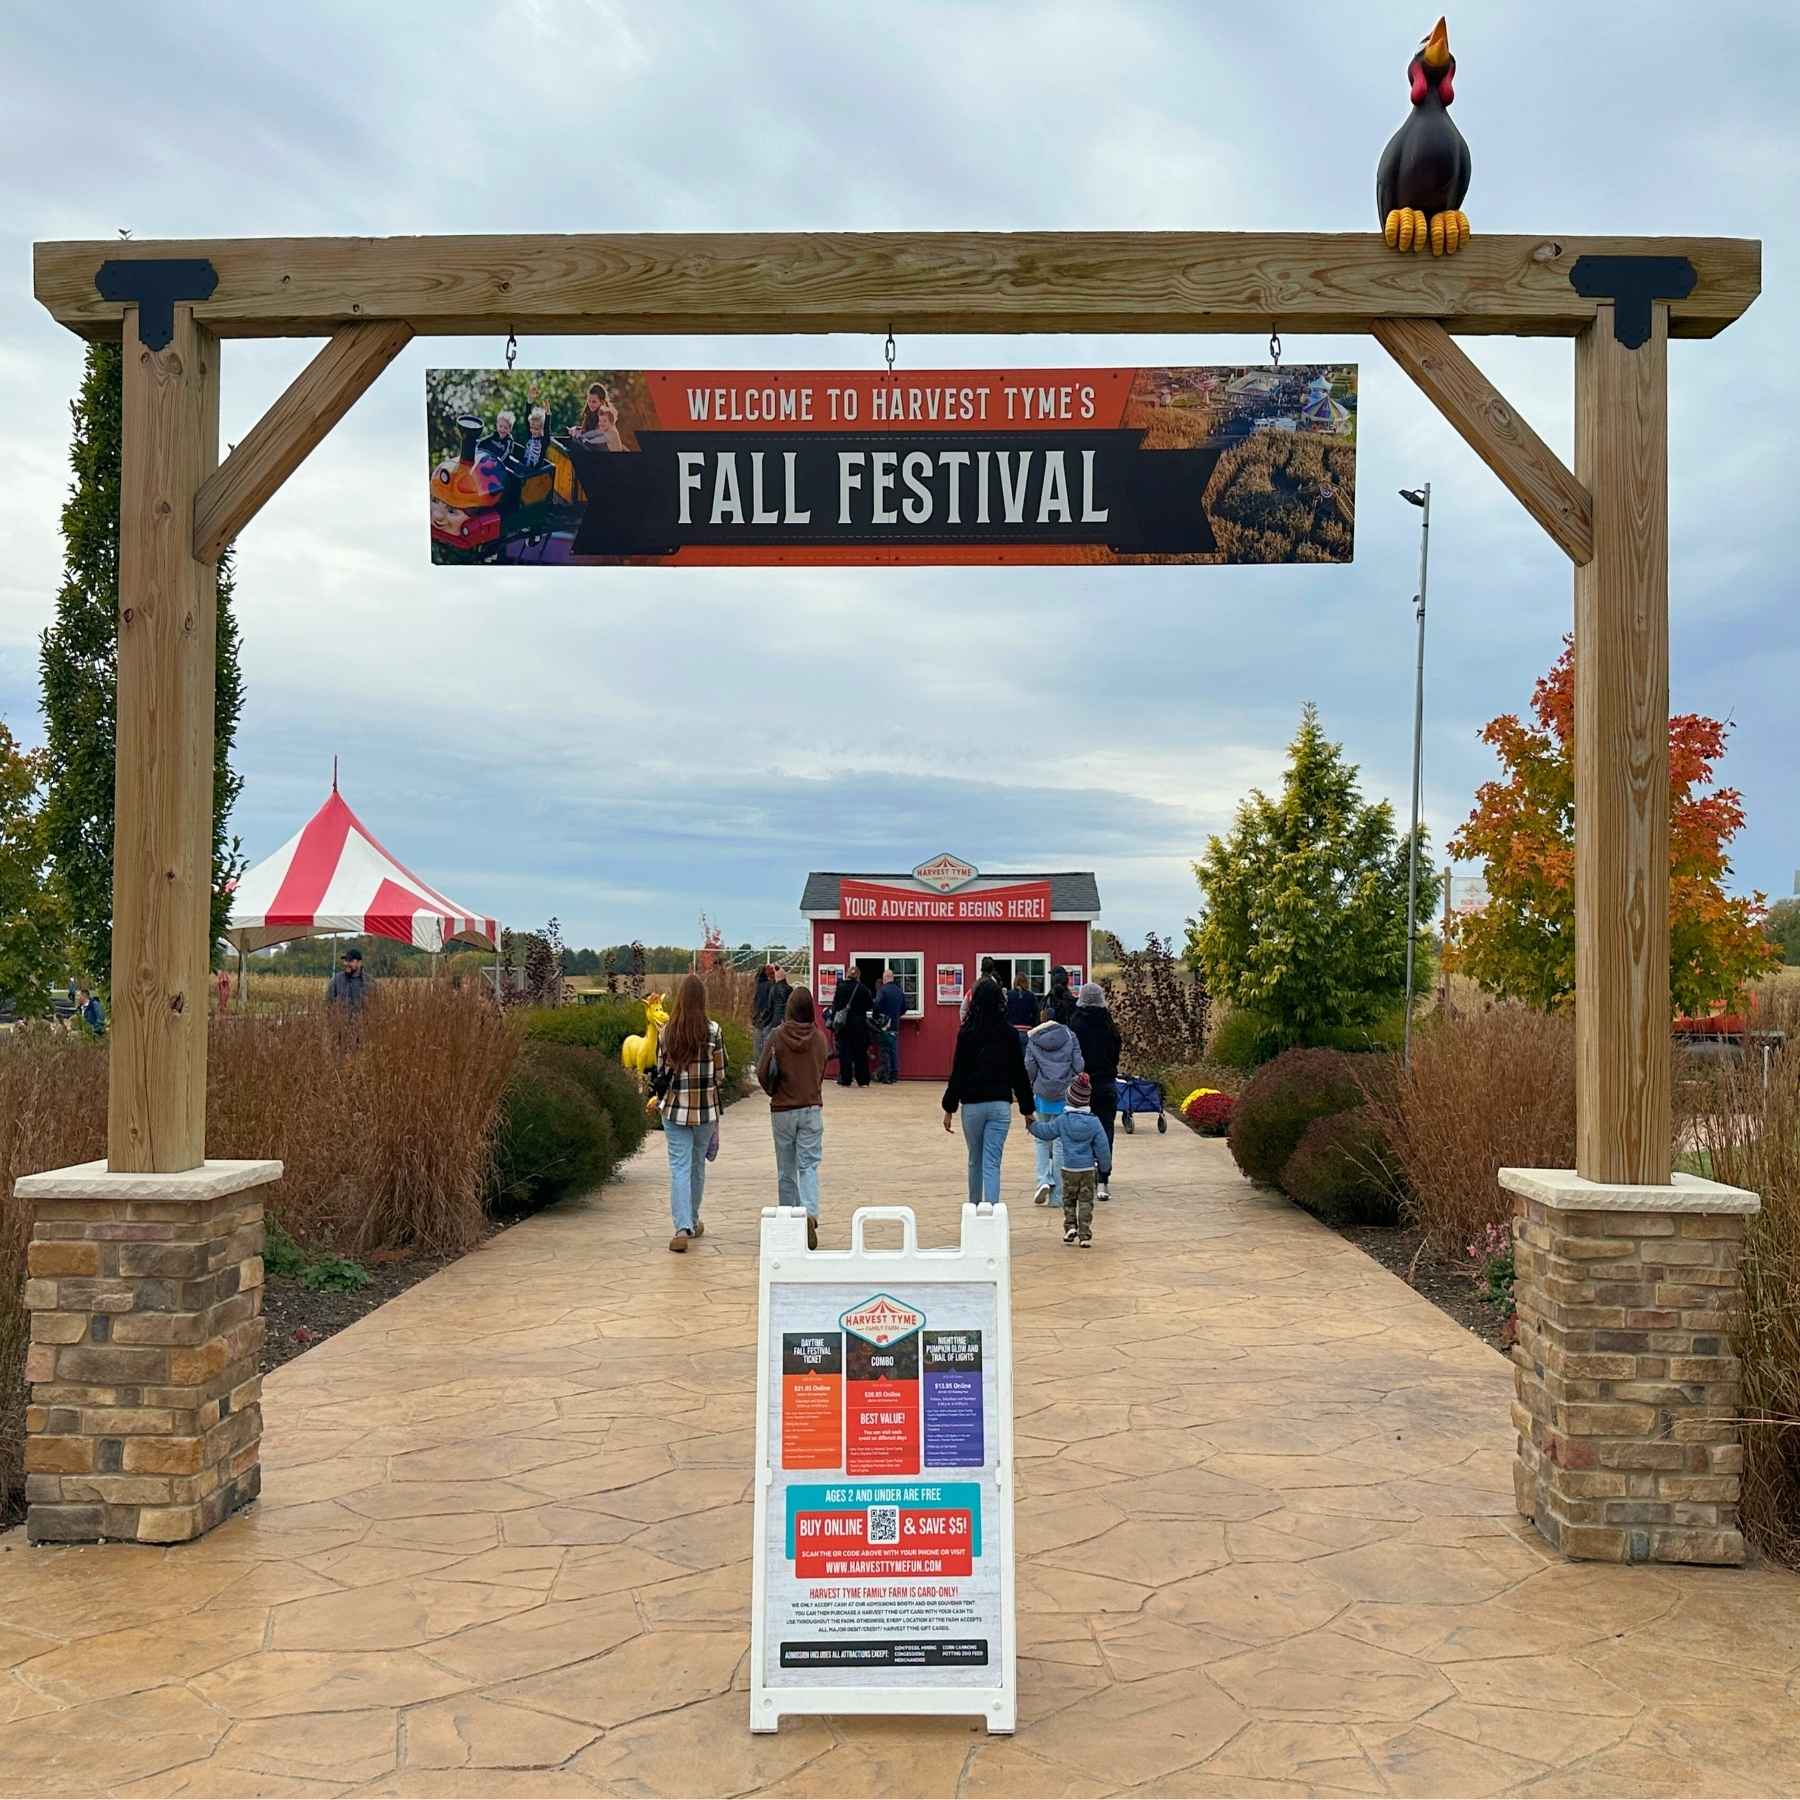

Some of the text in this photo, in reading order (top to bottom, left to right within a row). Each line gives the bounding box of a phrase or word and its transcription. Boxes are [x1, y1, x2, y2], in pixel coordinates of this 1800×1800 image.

[686, 383, 1095, 421] WELCOME TO HARVEST TYME'S
[677, 450, 1110, 524] FALL FESTIVAL
[917, 868, 972, 877] HARVEST TYME
[844, 897, 1045, 918] YOUR ADVENTURE BEGINS HERE!
[846, 1314, 917, 1326] HARVEST TYME
[793, 1346, 832, 1356] FALL FESTIVAL
[926, 1345, 951, 1353] PUMPKIN
[967, 1344, 979, 1353] AND
[803, 1355, 822, 1364] TICKET
[871, 1356, 895, 1367] COMBO
[947, 1353, 954, 1361] OF
[860, 1412, 905, 1424] BEST VALUE!
[825, 1487, 942, 1503] AGES 2 AND UNDER ARE FREE
[800, 1518, 863, 1537] BUY ONLINE
[903, 1516, 967, 1535] & SAVE $5!
[950, 1548, 966, 1556] VISIT
[825, 1559, 942, 1574] WWW.HARVESTTYMEFUN.COM
[809, 1585, 958, 1599] HARVEST TYME FAMILY FARM IS CARD-ONLY!
